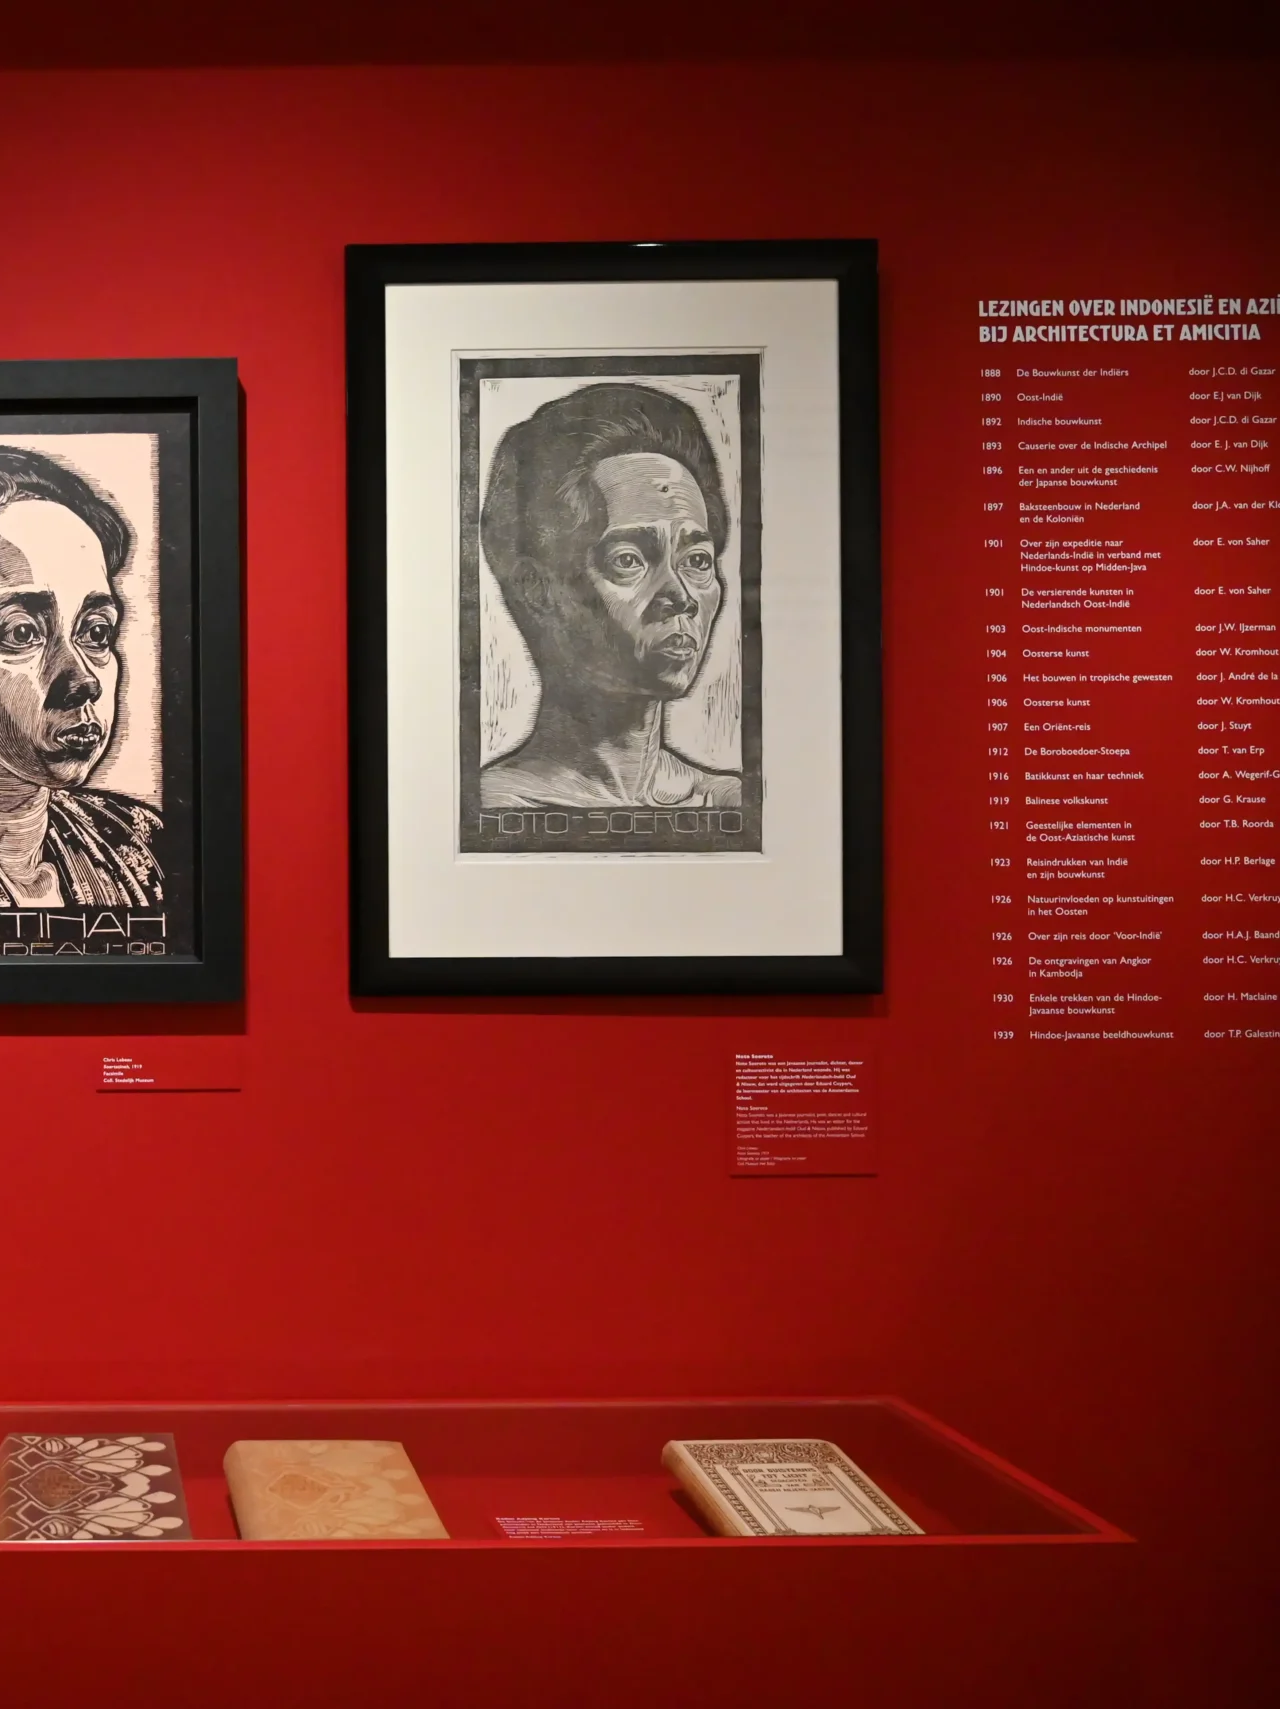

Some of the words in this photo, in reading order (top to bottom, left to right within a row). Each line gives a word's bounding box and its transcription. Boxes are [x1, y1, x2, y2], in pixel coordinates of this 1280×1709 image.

[979, 300, 1064, 317] LEZINGEN
[1069, 299, 1115, 316] OVER
[1121, 295, 1213, 316] INDONESIË
[1219, 299, 1241, 315] EN
[979, 326, 1007, 343] BIJ
[1012, 325, 1148, 342] ARCHITECTURA
[1153, 325, 1174, 341] ET
[1179, 324, 1260, 341] AMICITIA
[981, 369, 1001, 377] 1888
[1016, 368, 1030, 377] De
[1032, 368, 1080, 377] Bouwkunst
[1082, 368, 1097, 377] der
[1100, 368, 1129, 377] Indiërs
[1188, 368, 1210, 376] door
[1240, 367, 1248, 376] di
[1250, 366, 1276, 375] Gazar
[982, 418, 1002, 426] 1892
[1017, 417, 1052, 426] Indische
[1055, 417, 1102, 426] bouwkunst
[1190, 416, 1211, 425] door
[1241, 416, 1249, 424] di
[1252, 415, 1277, 424] Gazar
[982, 442, 1002, 451] 1893
[1018, 441, 1056, 450] Causerie
[1080, 441, 1091, 450] de
[1094, 441, 1129, 450] Indische
[1131, 441, 1167, 451] Archipel
[1190, 440, 1212, 449] door
[1250, 439, 1268, 450] Dijk
[985, 588, 1004, 597] 1901
[1021, 588, 1034, 597] De
[1037, 588, 1087, 596] versierende
[1089, 587, 1123, 596] kunsten
[1126, 588, 1134, 596] in
[1194, 586, 1215, 595] door
[1247, 586, 1271, 595] Saher
[1022, 600, 1081, 609] Nederlandsch
[1083, 599, 1130, 608] Oost-Indië
[986, 625, 1006, 634] 1903
[1022, 624, 1082, 633] Oost-Indische
[1195, 623, 1216, 632] door
[1239, 623, 1276, 634] IJzerman
[987, 649, 1007, 658] 1904
[1022, 649, 1063, 658] Oosterse
[1065, 649, 1089, 658] kunst
[1195, 648, 1217, 657] door
[1235, 647, 1279, 656] Kromhout
[988, 698, 1008, 707] 1906
[1023, 698, 1064, 707] Oosterse
[1067, 698, 1090, 707] kunst
[1197, 697, 1218, 706] door
[988, 723, 1008, 732] 1907
[1024, 722, 1040, 732] Een
[1042, 722, 1091, 731] Oriënt-reis
[1197, 722, 1219, 730] door
[1229, 721, 1252, 732] Stuyt
[988, 747, 1008, 756] 1912
[1024, 747, 1038, 756] De
[1040, 746, 1130, 758] Boroboedoer-Stoepa
[1198, 746, 1219, 755] door
[1249, 745, 1265, 756] Erp
[989, 796, 1010, 805] 1919
[1025, 796, 1060, 805] Balinese
[1063, 796, 1108, 805] volkskunst
[1199, 795, 1220, 804] door
[1236, 795, 1266, 804] Krause
[990, 821, 1008, 830] 1921
[1026, 820, 1073, 831] Geestelijke
[1076, 821, 1121, 829] elementen
[1124, 821, 1132, 829] in
[1199, 820, 1221, 829] door
[1242, 819, 1274, 828] Roorda
[1026, 834, 1037, 842] de
[1039, 833, 1109, 842] Oost-Aziatische
[1111, 833, 1135, 841] kunst
[994, 1031, 1014, 1040] 1939
[1030, 1030, 1100, 1042] Hindoe-Javaanse
[1103, 1030, 1174, 1039] beeldhouwkunst
[1204, 1030, 1225, 1038] door
